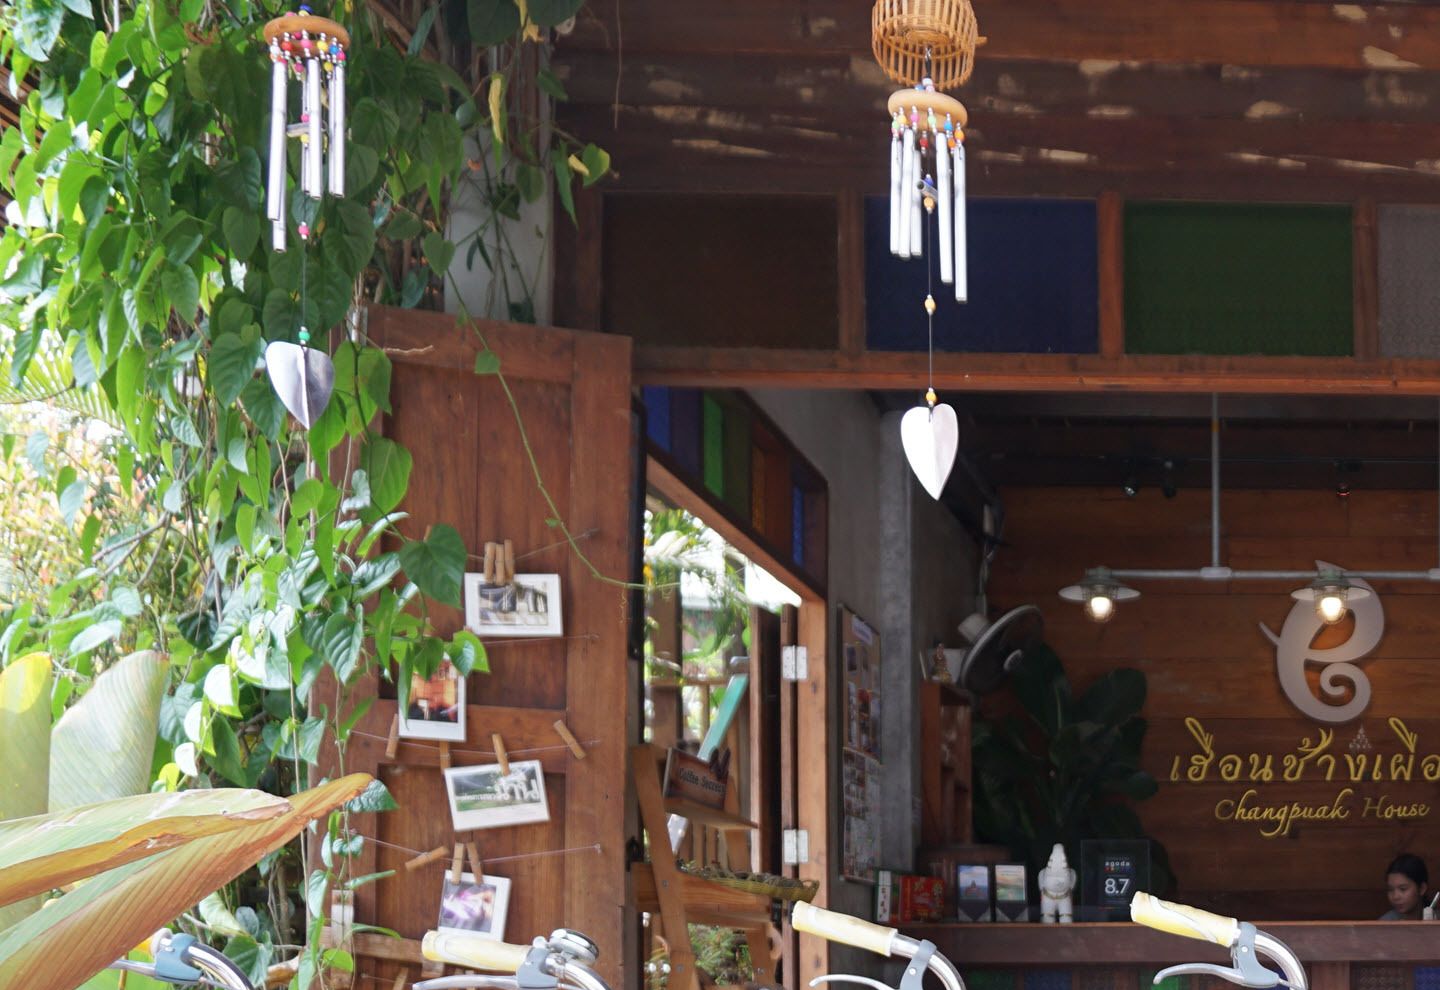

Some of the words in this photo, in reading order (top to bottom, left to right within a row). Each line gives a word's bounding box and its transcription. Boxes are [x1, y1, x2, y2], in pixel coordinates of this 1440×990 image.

[1214, 788, 1353, 837] Changpuak
[1361, 794, 1431, 819] House
[1104, 878, 1130, 894] 8.7
